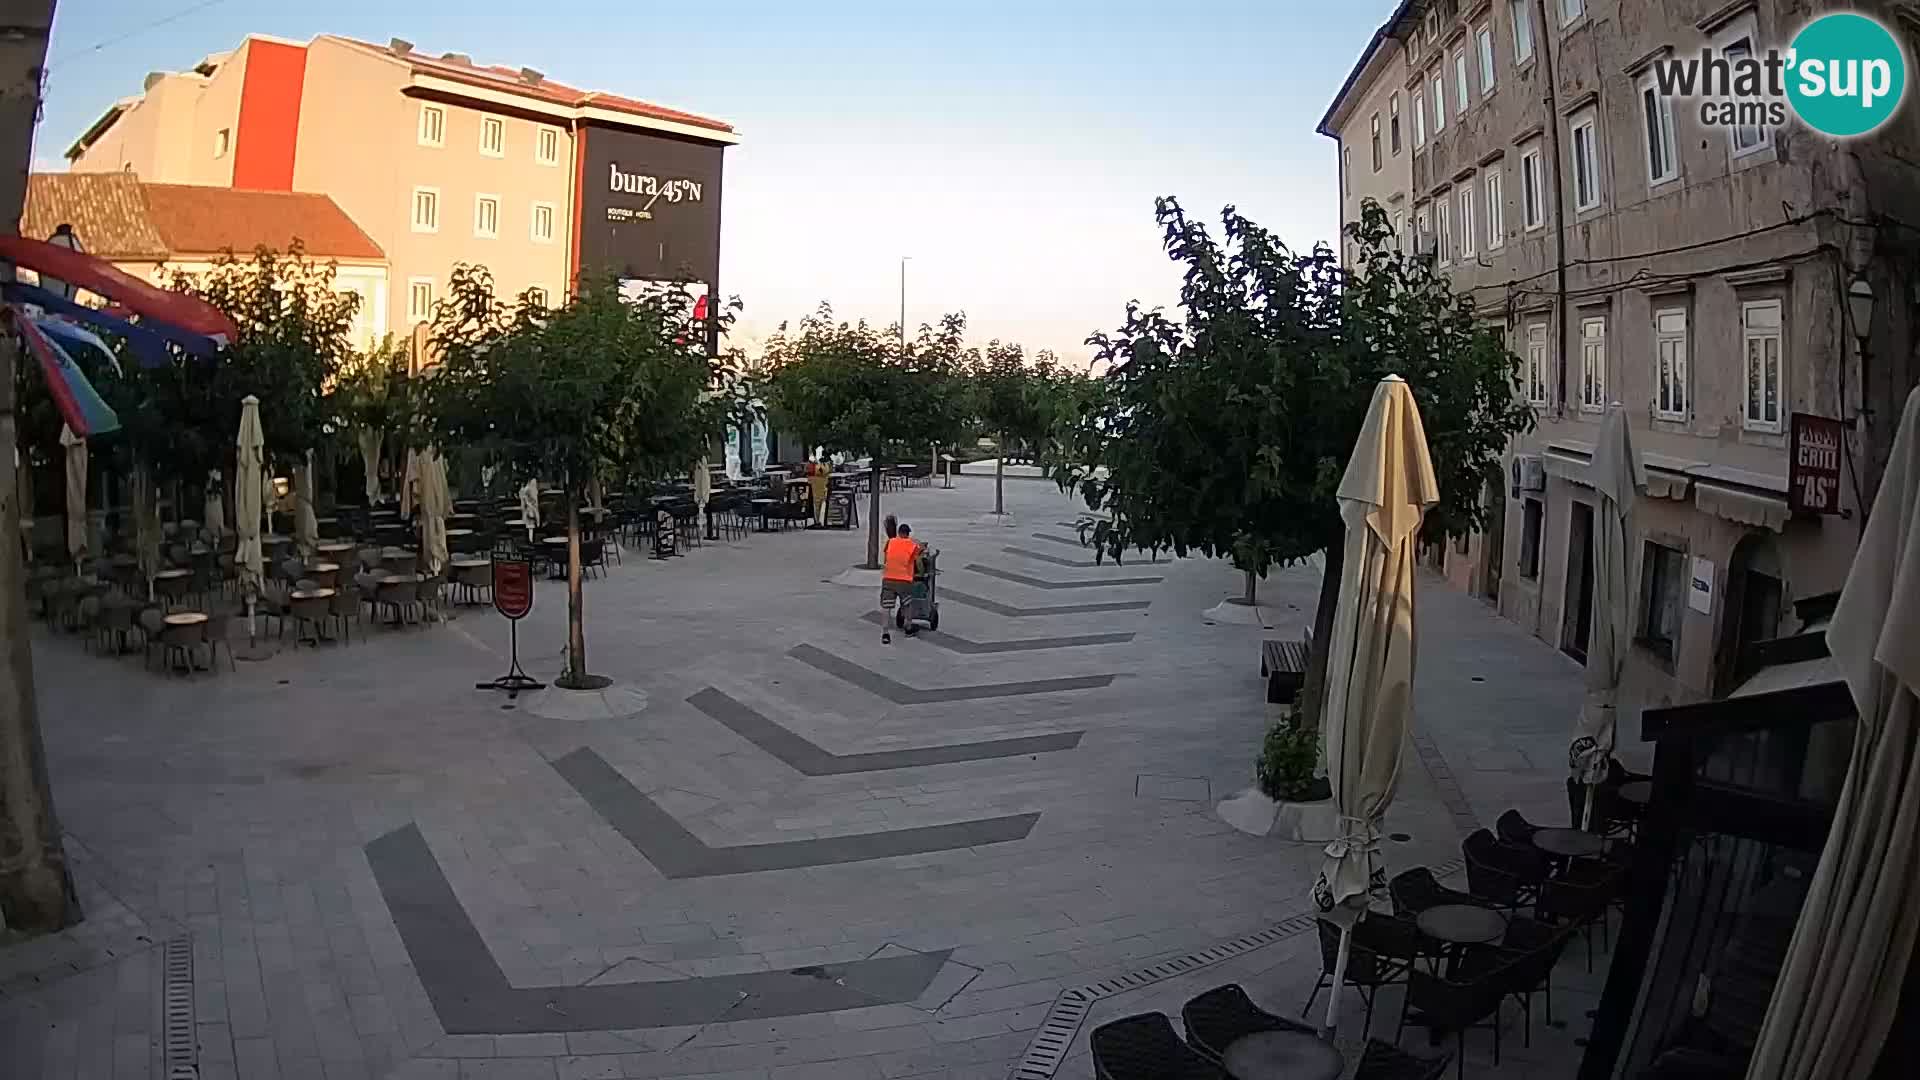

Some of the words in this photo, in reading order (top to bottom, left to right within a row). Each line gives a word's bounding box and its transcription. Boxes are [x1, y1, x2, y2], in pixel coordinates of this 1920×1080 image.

[610, 164, 657, 195] bura
[1798, 448, 1837, 470] GRILL
[1797, 475, 1836, 508] "AS"
